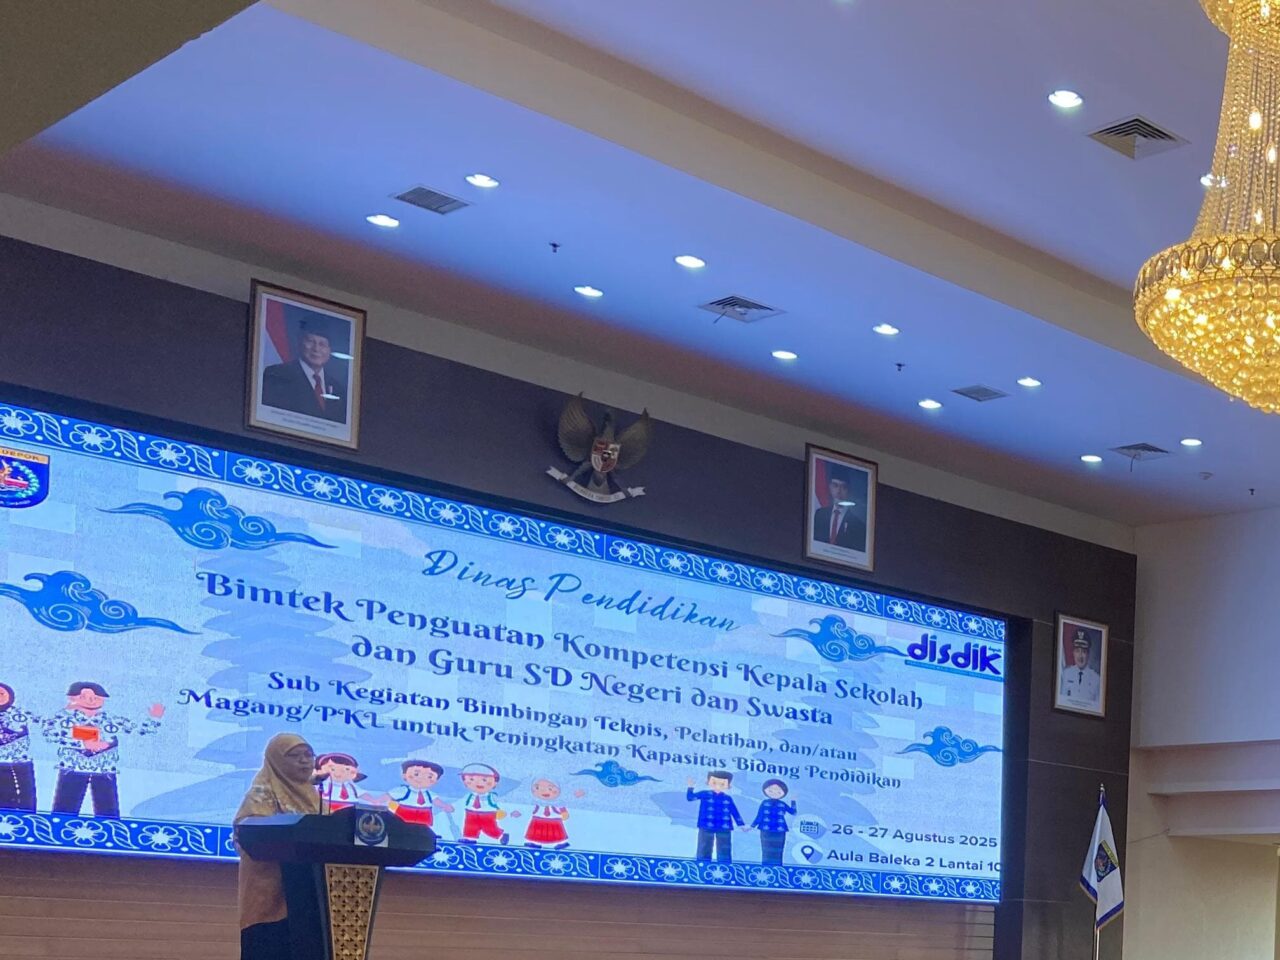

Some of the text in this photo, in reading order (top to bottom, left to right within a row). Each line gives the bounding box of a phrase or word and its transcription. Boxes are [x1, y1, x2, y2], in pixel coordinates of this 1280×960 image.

[422, 550, 741, 632] Dinas Pendidikan
[195, 572, 923, 710] Bimtek Penguatan Kompetensi Kepala Sekolah
[351, 635, 833, 725] dan Guru SD Negeri dan Swasta
[907, 633, 1001, 675] disdik
[178, 688, 902, 788] Magang/PKL untuk Peningkatan Kapasitas Bidang Pendidikan
[268, 671, 857, 762] Sub Kegiatan Bimbingan Teknis, Pelatihan, dan/atau
[826, 849, 864, 863] Aula
[868, 852, 921, 867] Baleka
[925, 856, 935, 867] 2
[939, 857, 983, 871] Lantai
[831, 823, 854, 835] 26
[868, 827, 889, 838] 27
[892, 829, 955, 844] Agustus
[959, 835, 998, 848] 2025
